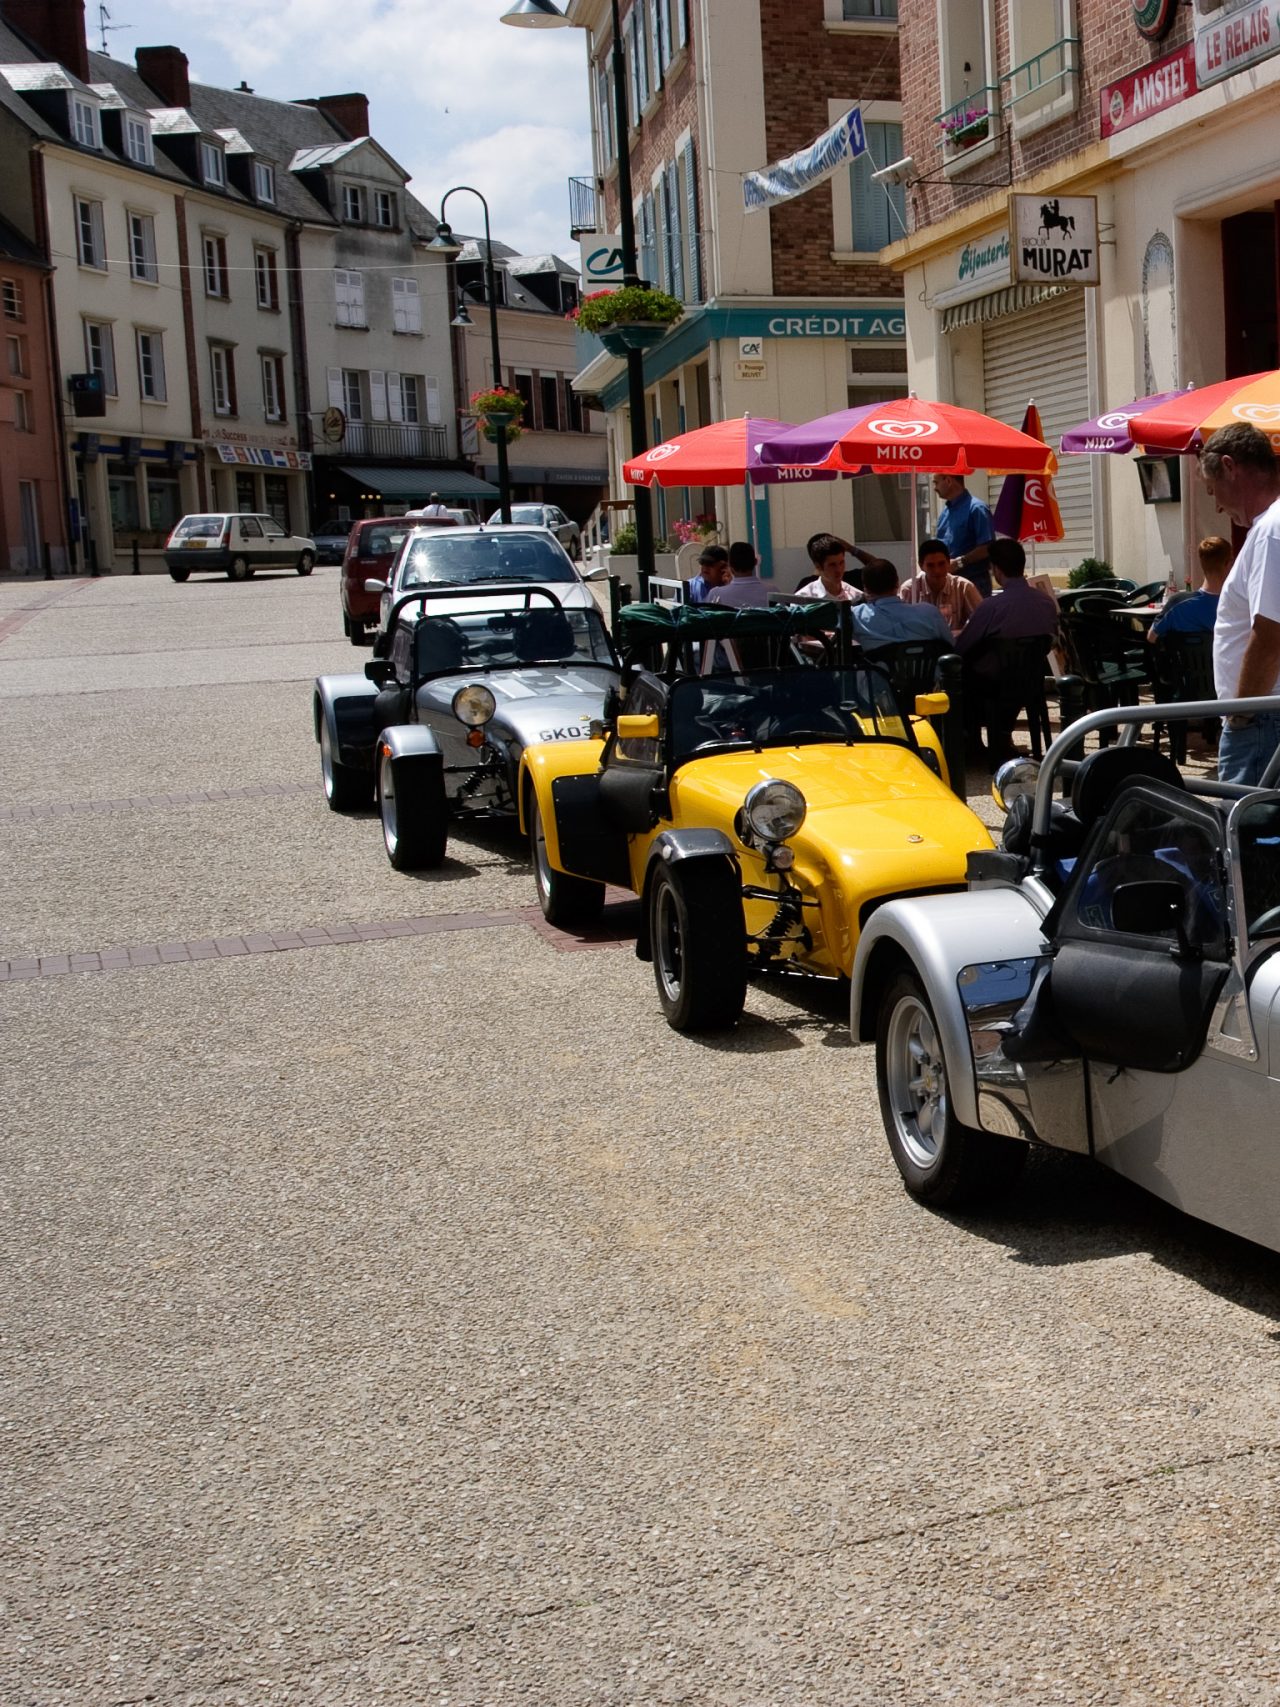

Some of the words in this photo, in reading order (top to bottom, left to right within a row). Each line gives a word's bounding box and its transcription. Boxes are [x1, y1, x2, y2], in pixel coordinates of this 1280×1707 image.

[1206, 32, 1222, 70] LE
[1225, 6, 1270, 62] RELAIS
[1132, 59, 1188, 117] AMSTEL
[1021, 237, 1048, 247] BIJOUX
[1023, 248, 1092, 277] MURAT
[769, 314, 864, 335] CRÉDIT
[1085, 436, 1115, 449] MIKO
[877, 446, 922, 460] MIKO
[777, 467, 813, 480] MIKO
